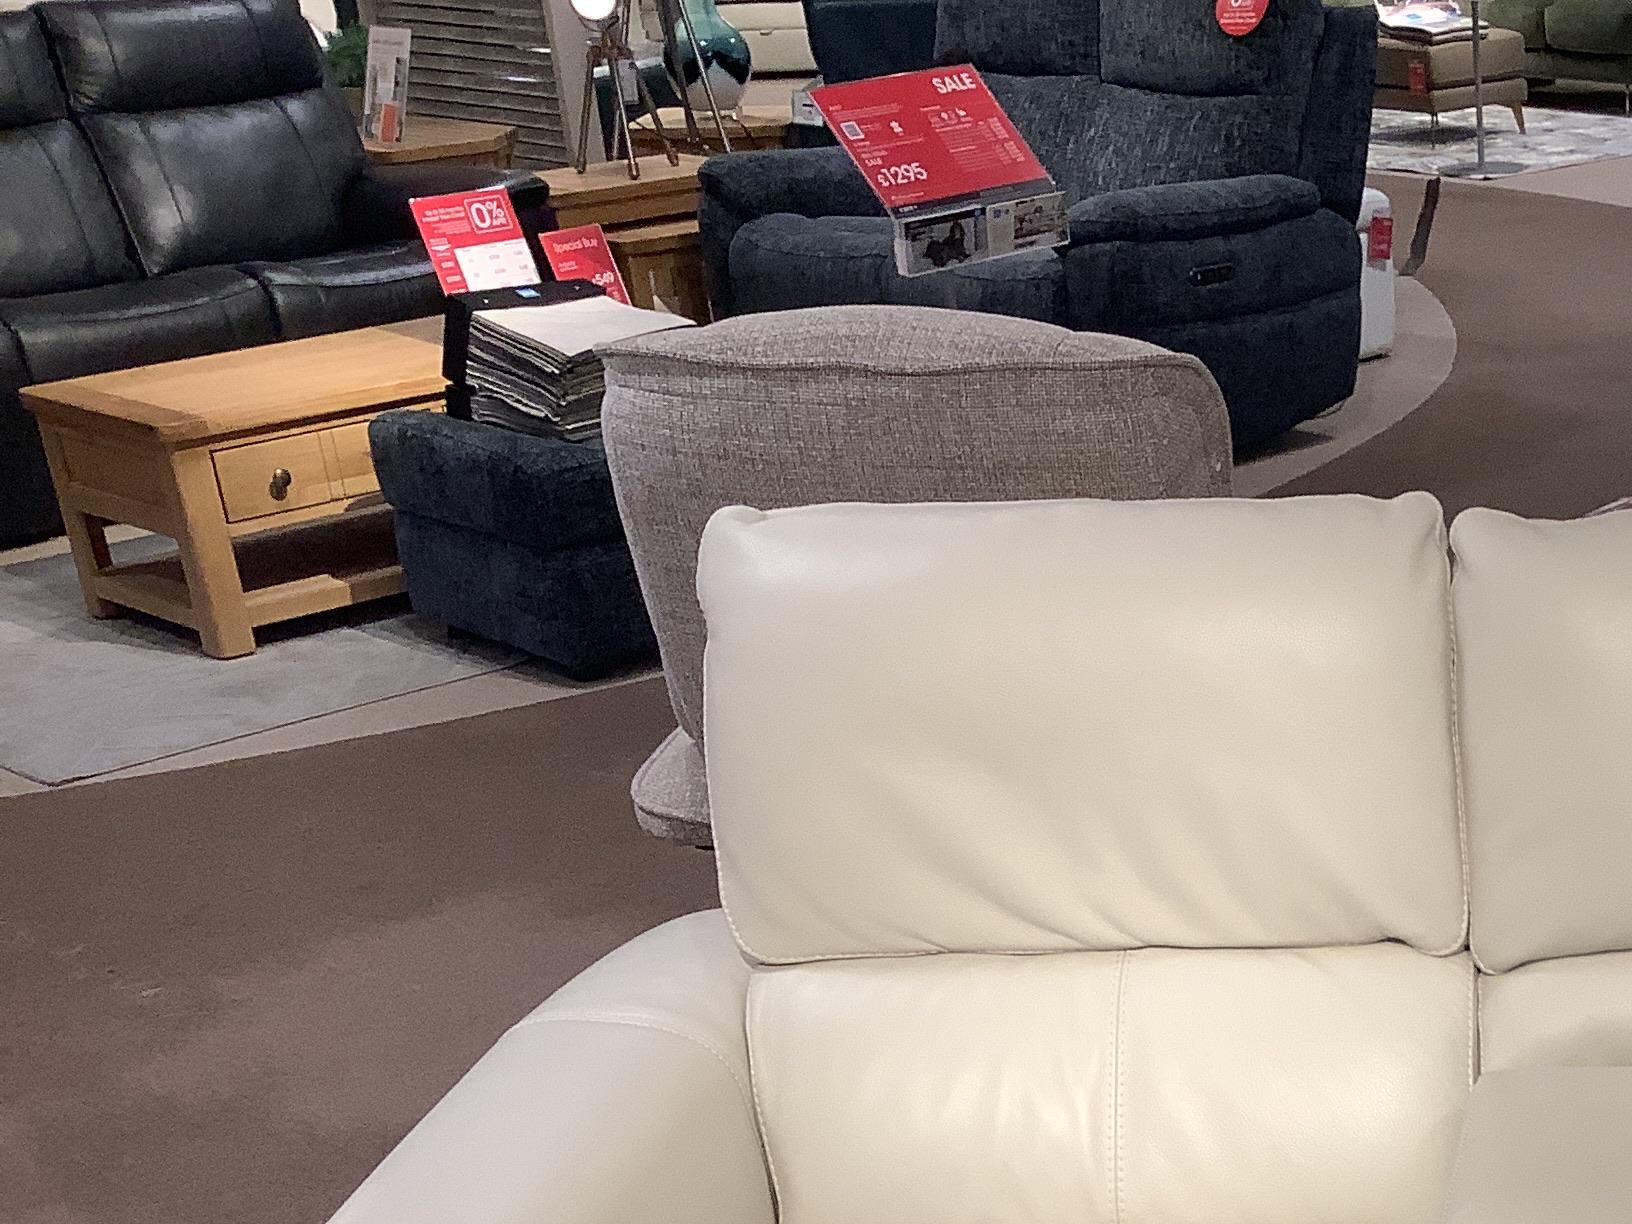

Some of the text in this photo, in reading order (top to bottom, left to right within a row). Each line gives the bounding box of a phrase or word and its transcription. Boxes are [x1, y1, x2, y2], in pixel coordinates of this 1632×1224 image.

[932, 72, 976, 94] SALE
[877, 162, 928, 187] £1295
[470, 200, 505, 229] 0%
